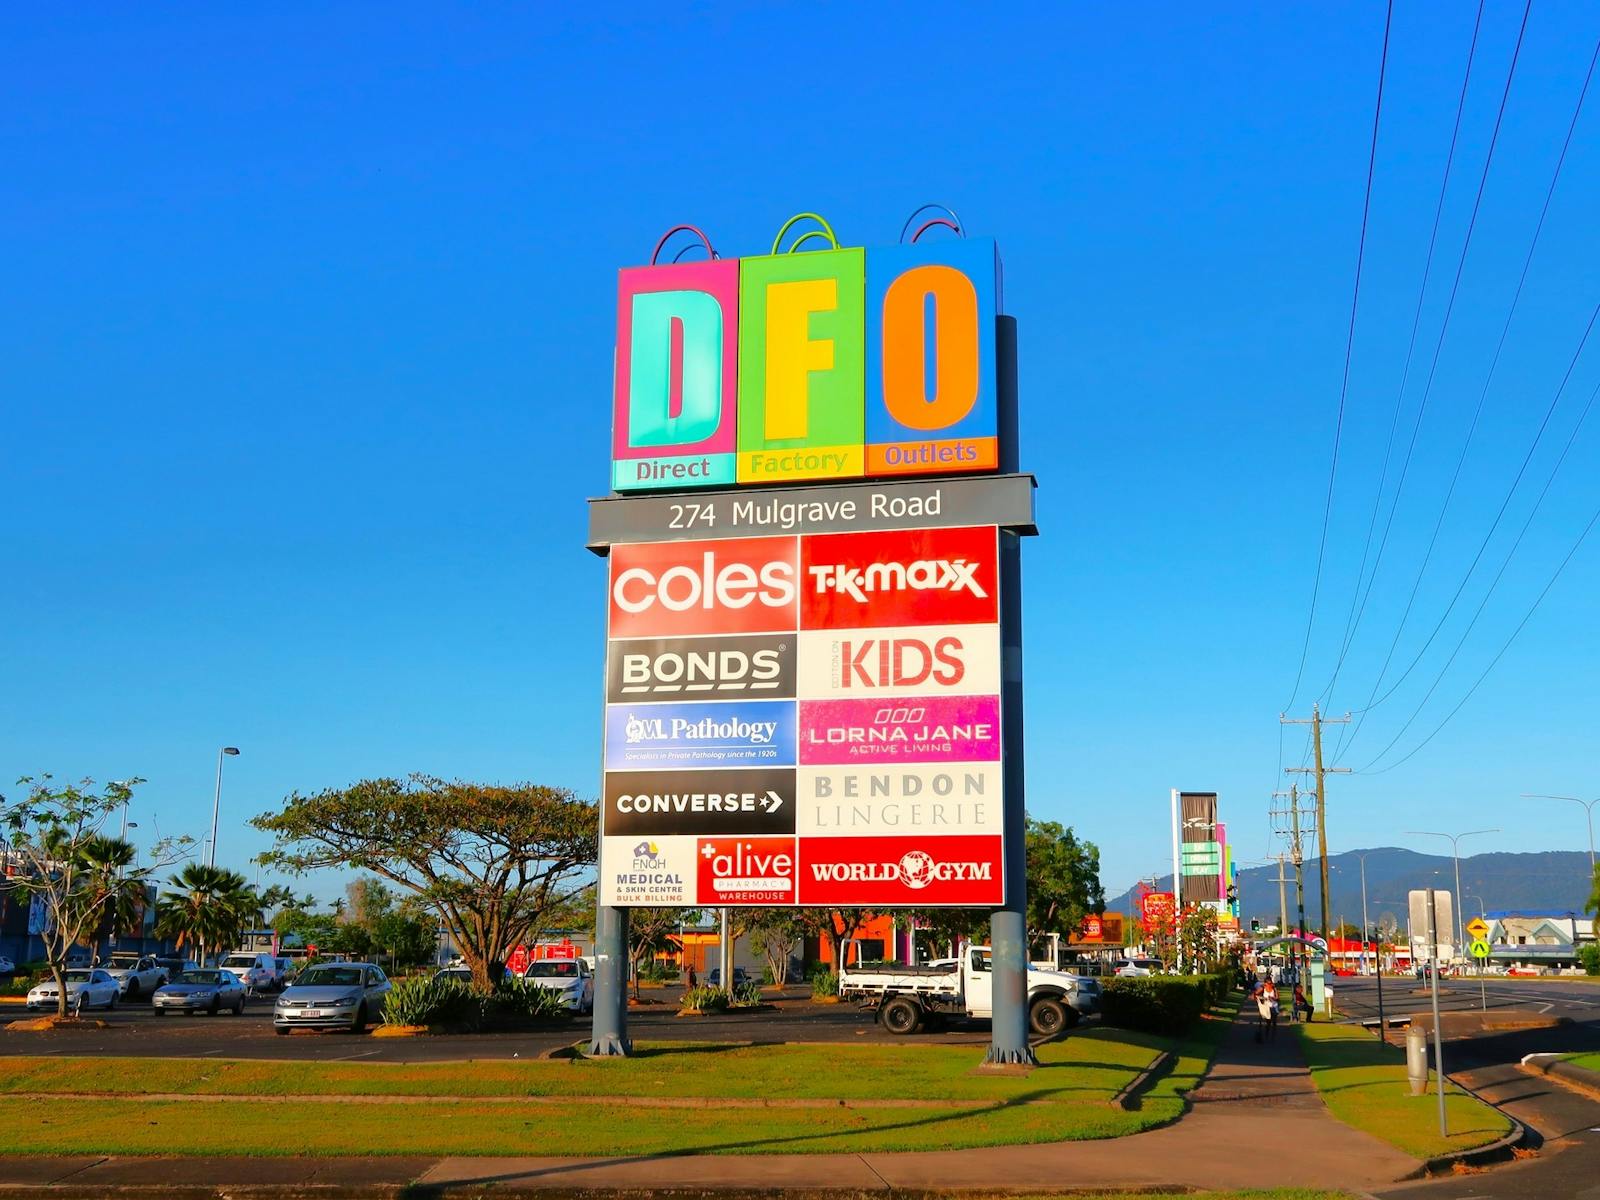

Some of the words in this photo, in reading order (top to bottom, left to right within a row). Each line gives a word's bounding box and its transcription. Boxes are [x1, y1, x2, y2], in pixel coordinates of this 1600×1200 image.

[637, 458, 710, 481] Direct
[751, 450, 849, 476] Factory
[885, 441, 977, 467] Outlets
[668, 503, 716, 529] 274
[732, 498, 857, 530] Mulgrave
[871, 490, 942, 518] Road
[613, 551, 796, 614] coles
[622, 649, 780, 685] BONDS
[841, 636, 965, 689] KIDS
[671, 717, 778, 743] Pathology
[809, 726, 907, 744] LORNA
[912, 723, 993, 742] JANE
[668, 750, 690, 760] Private
[692, 750, 725, 760] Pathology
[727, 750, 744, 758] since
[745, 749, 756, 758] the
[758, 749, 777, 758] 1920s
[849, 744, 901, 754] ACTIVE
[904, 742, 952, 753] LIVING
[814, 773, 986, 798] BENDON
[616, 793, 756, 814] CONVERSE
[815, 803, 986, 827] LINGERIE
[632, 858, 666, 870] FNQH
[712, 842, 792, 877] alive
[616, 874, 683, 885] MEDICAL
[810, 863, 902, 882] WORLD
[932, 861, 993, 881] GYM
[718, 880, 785, 888] PHARMACY
[718, 892, 785, 901] WAREHOUSE
